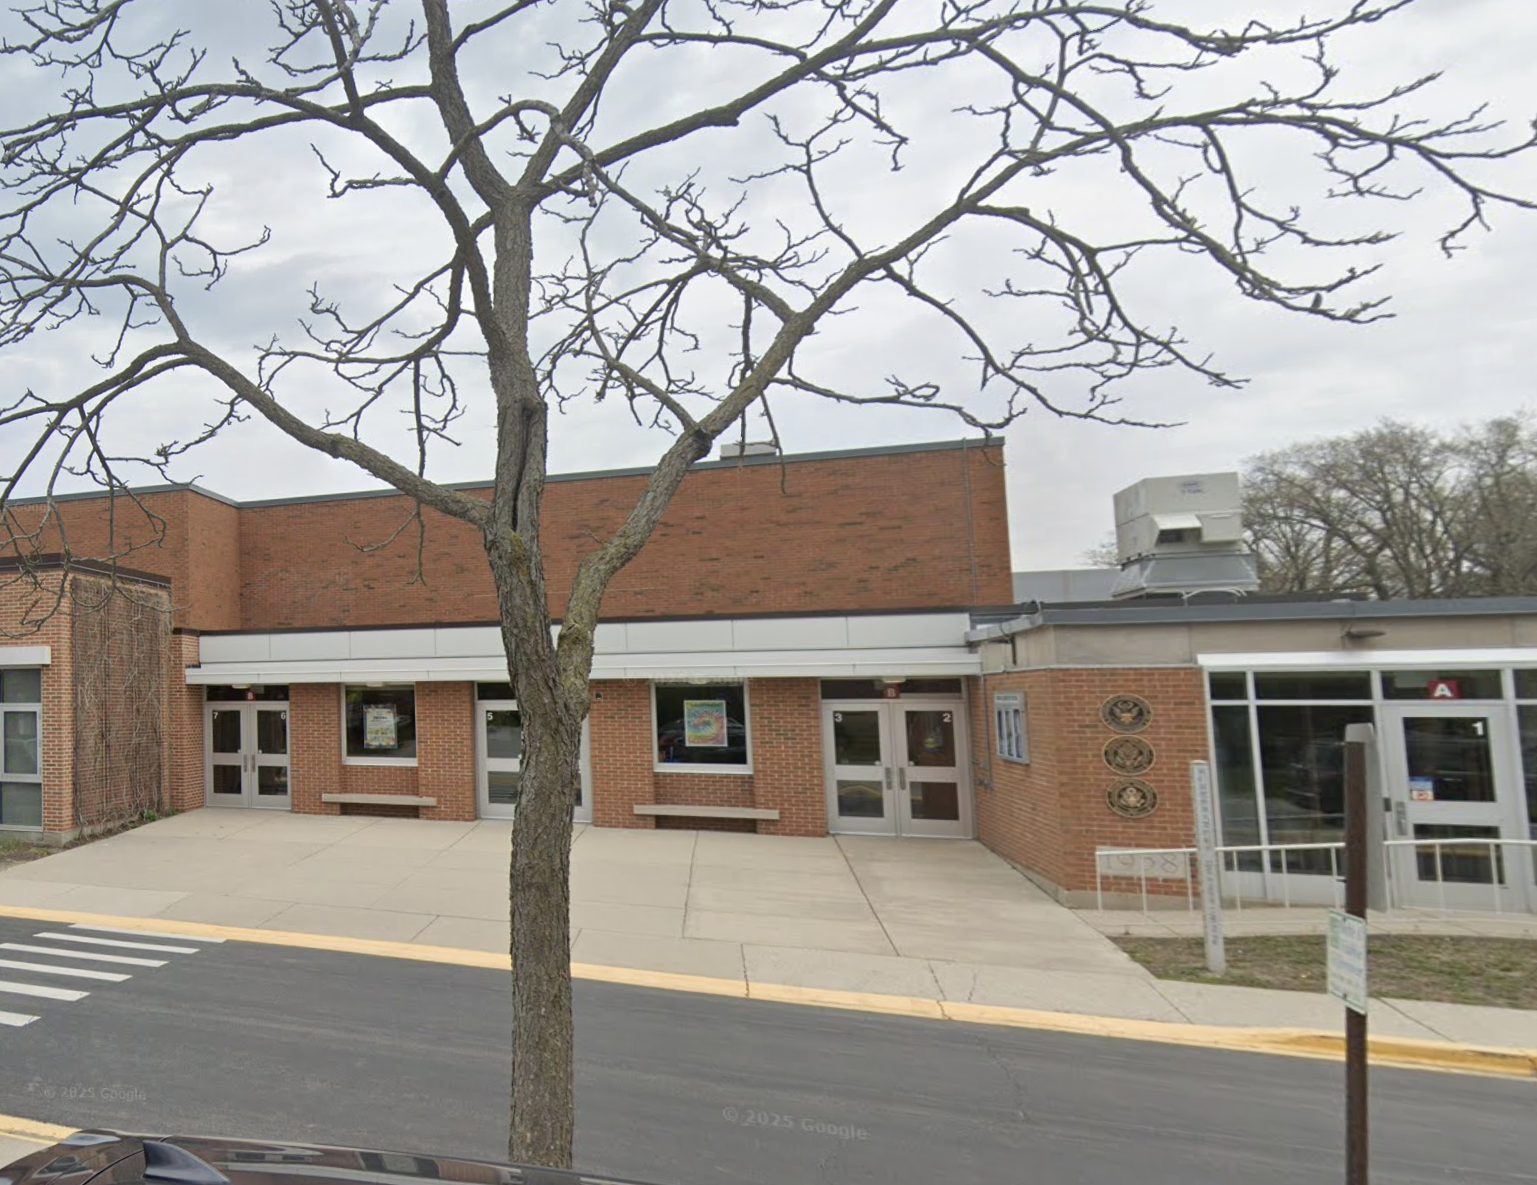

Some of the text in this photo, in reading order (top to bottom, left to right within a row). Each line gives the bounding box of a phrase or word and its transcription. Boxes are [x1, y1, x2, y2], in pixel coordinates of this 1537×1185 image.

[887, 688, 896, 697] B
[1434, 683, 1453, 697] A
[213, 711, 219, 719] 7
[280, 712, 286, 720] 6
[487, 712, 493, 721] 5
[834, 713, 843, 722] 3
[942, 713, 951, 722] 2
[1472, 721, 1484, 736] 1
